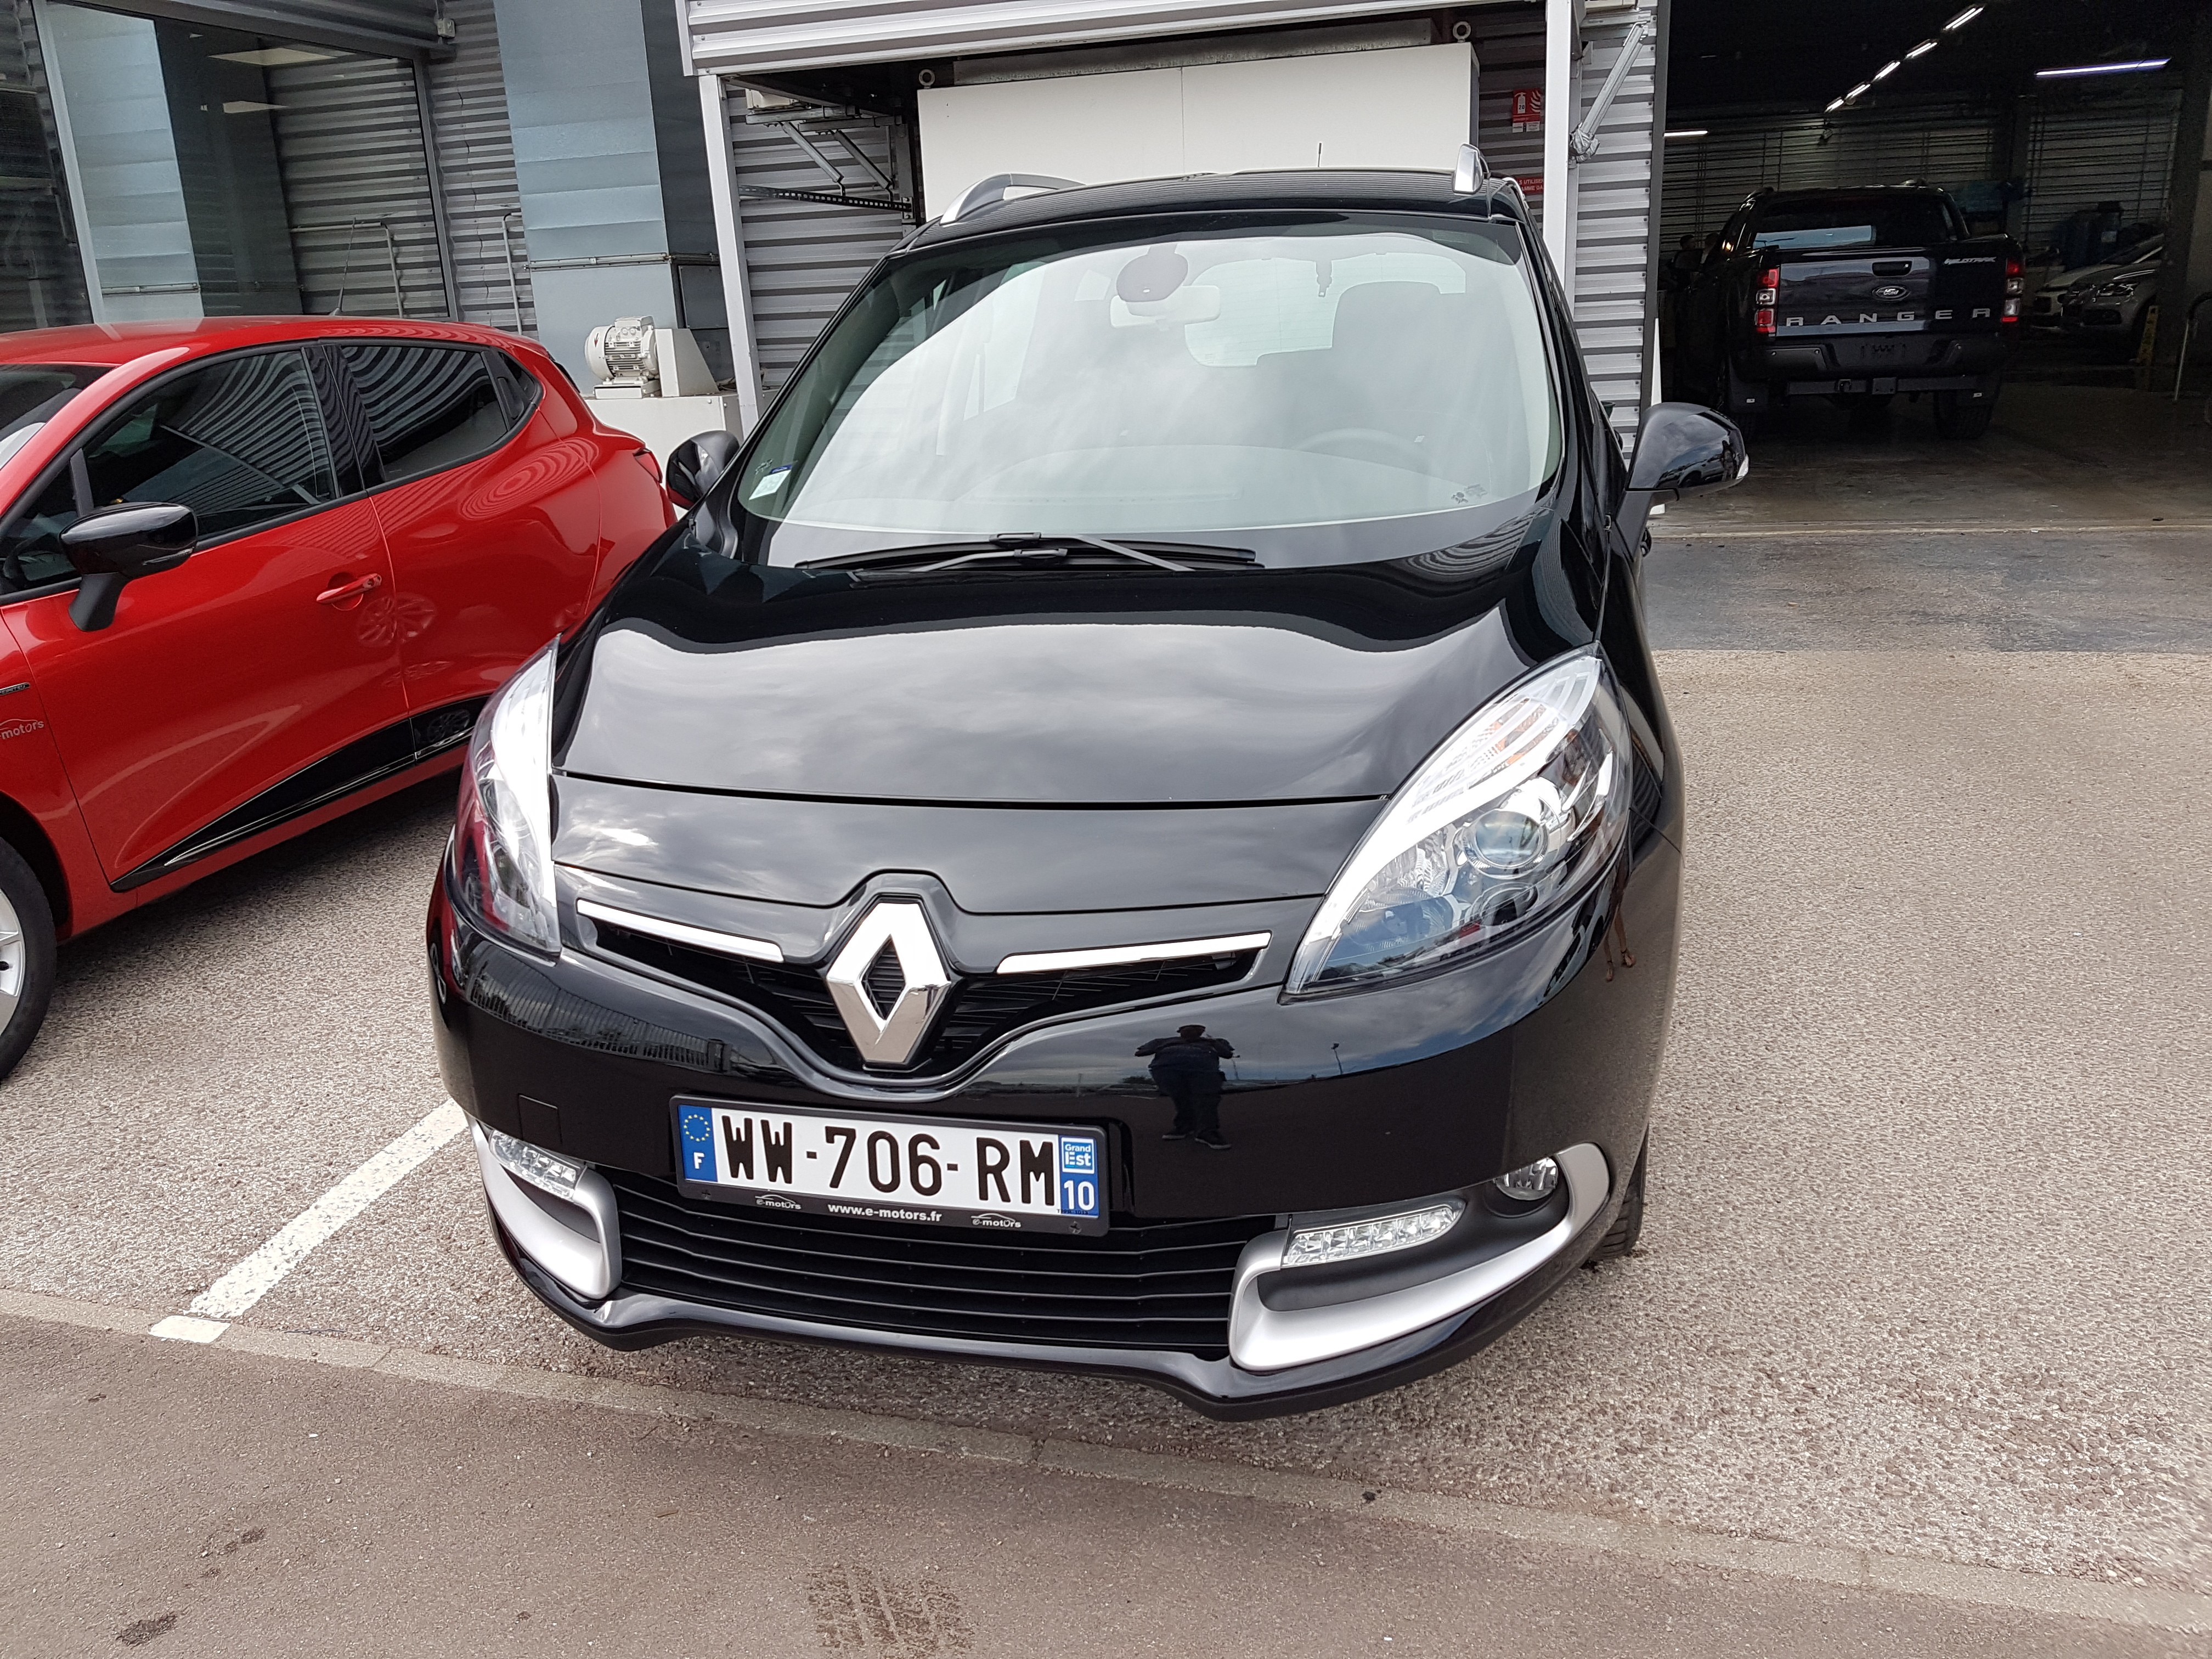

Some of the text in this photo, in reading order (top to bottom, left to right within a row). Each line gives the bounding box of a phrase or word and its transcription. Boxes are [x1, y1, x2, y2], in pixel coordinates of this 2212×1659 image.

[1786, 308, 1990, 326] RANGER
[1065, 1144, 1091, 1152] Grand
[693, 1151, 704, 1169] F
[1065, 1152, 1091, 1166] Est
[1064, 1180, 1094, 1210] 10
[828, 1204, 942, 1222] www.e-motors.fr
[973, 1218, 1022, 1228] e-motors
